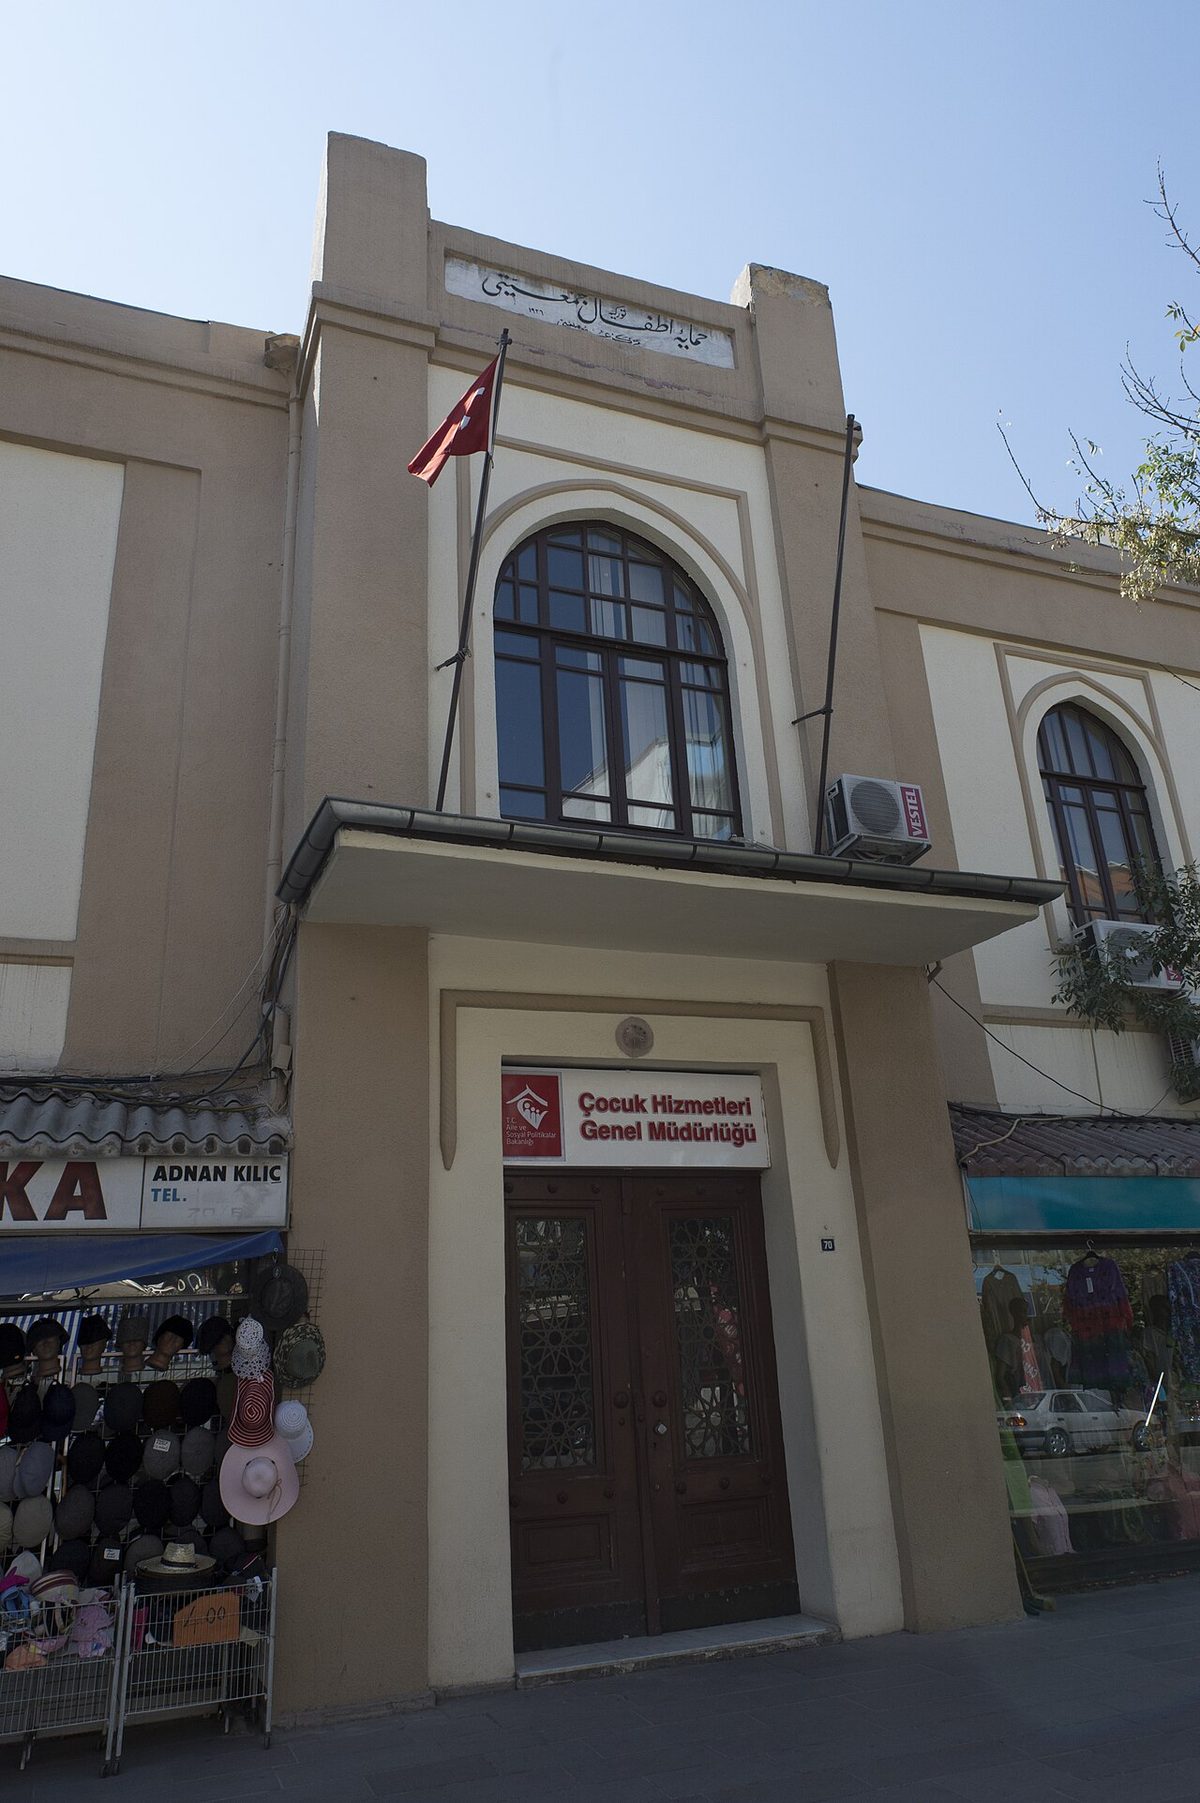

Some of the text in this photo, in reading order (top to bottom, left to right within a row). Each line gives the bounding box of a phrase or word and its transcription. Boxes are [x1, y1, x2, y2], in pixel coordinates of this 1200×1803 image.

[905, 789, 923, 836] VESTEL
[577, 1091, 752, 1117] Çocuk Hizmetleri
[506, 1130, 557, 1139] Sosyal Politikalar
[580, 1119, 757, 1148] Genel Müdürlüğü
[152, 1165, 227, 1182] ADNAN
[151, 1188, 187, 1202] TEL.
[823, 1240, 833, 1249] 70
